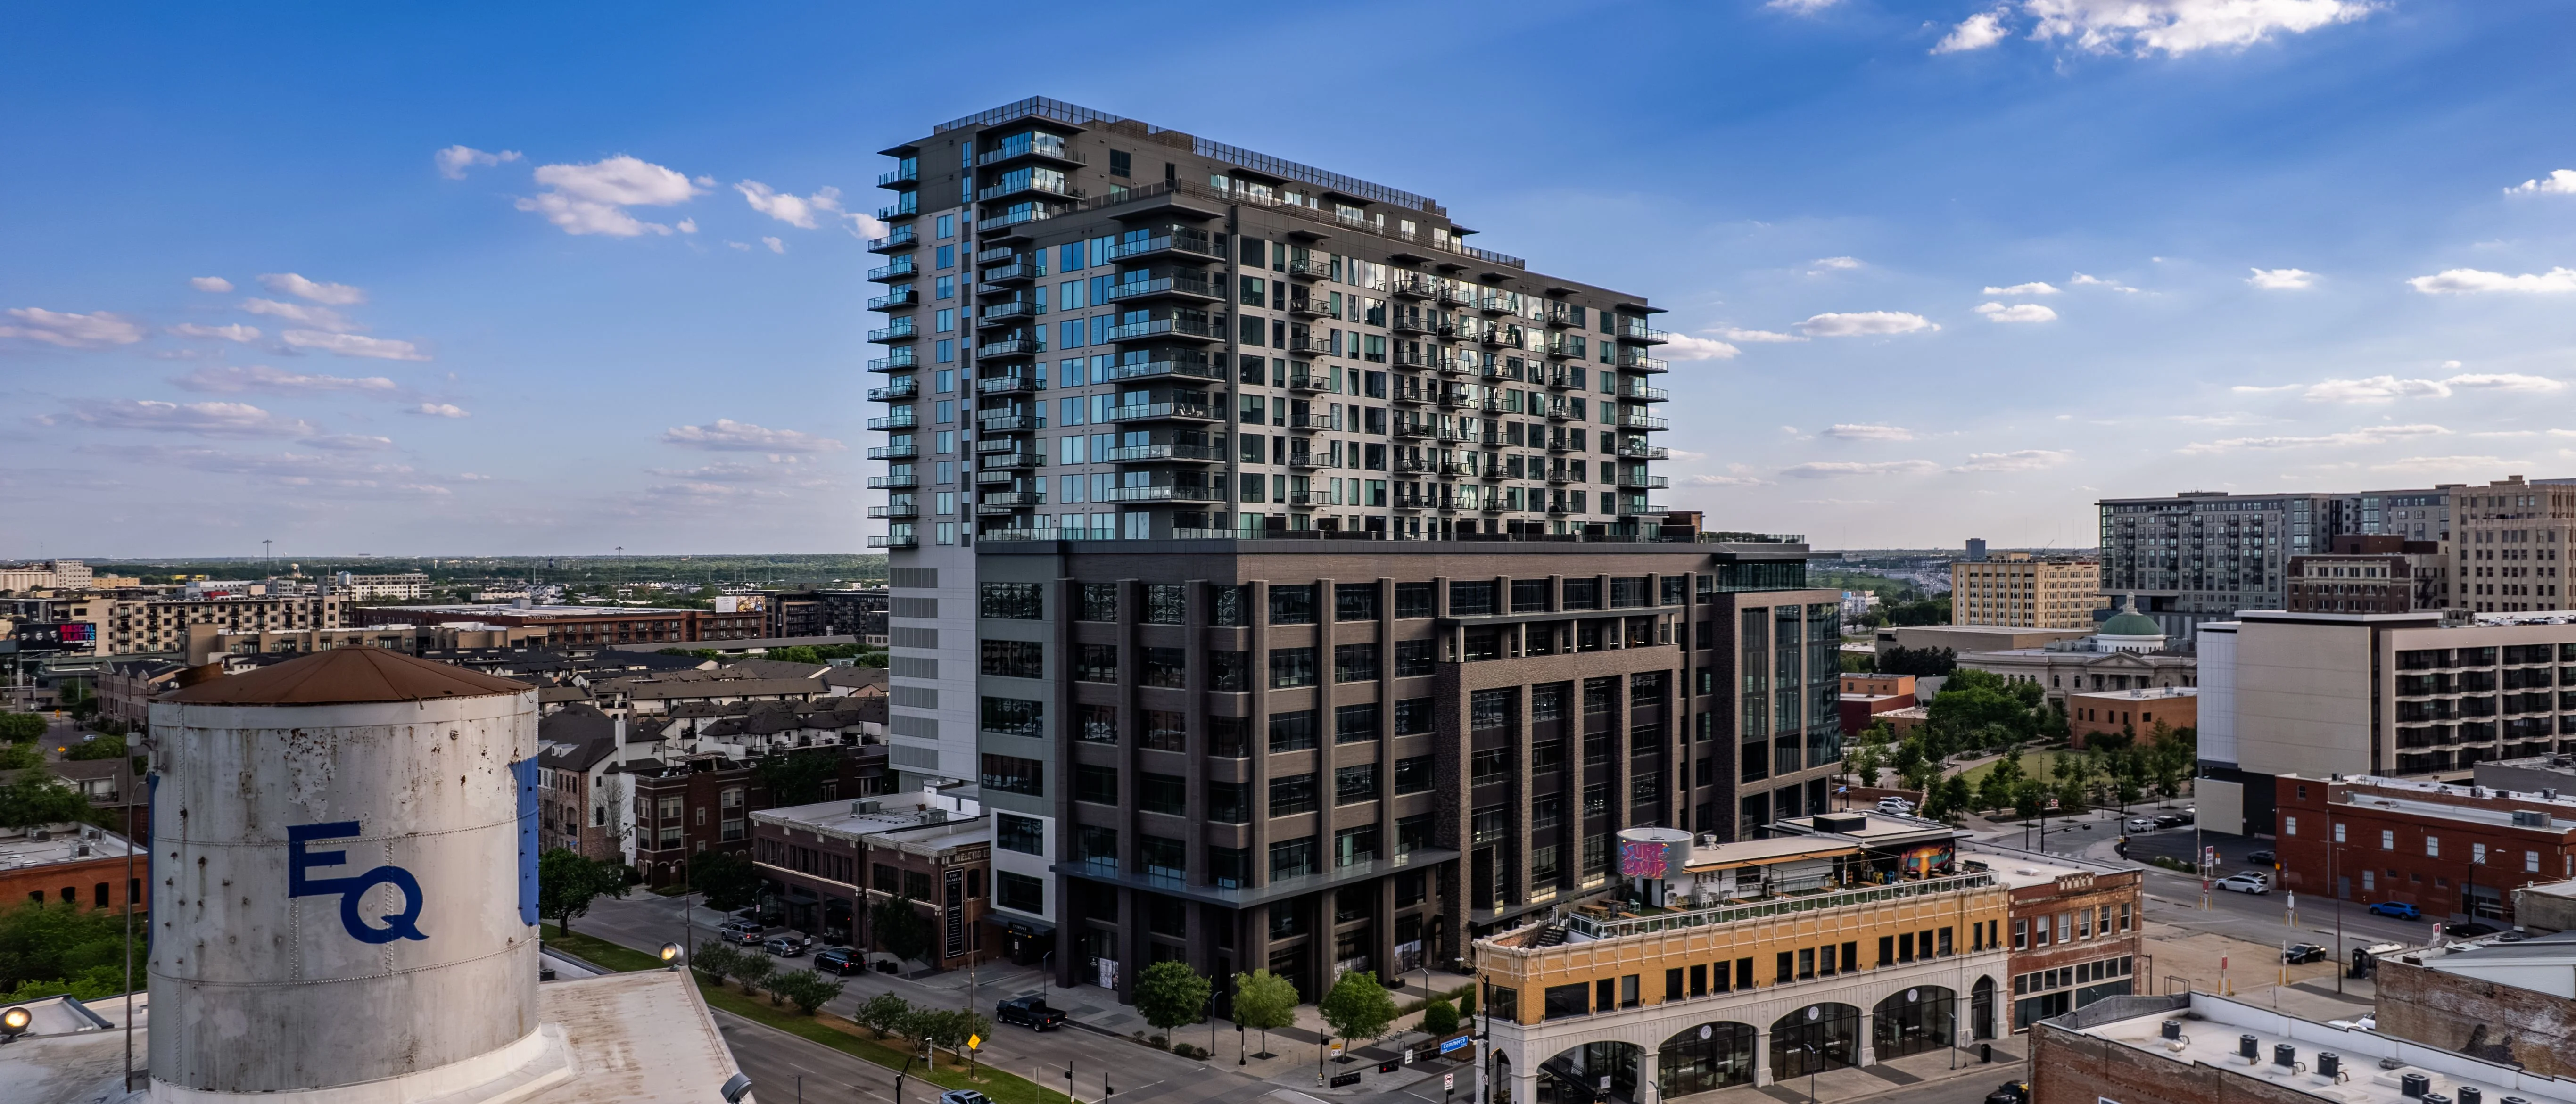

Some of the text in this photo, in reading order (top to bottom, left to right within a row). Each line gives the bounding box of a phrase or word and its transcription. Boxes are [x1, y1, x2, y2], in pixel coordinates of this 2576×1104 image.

[62, 633, 95, 641] FLATTS
[1623, 842, 1666, 860] SURF
[1623, 859, 1668, 880] CAMP
[286, 820, 430, 944] EQ
[1443, 1038, 1465, 1049] Commerce
